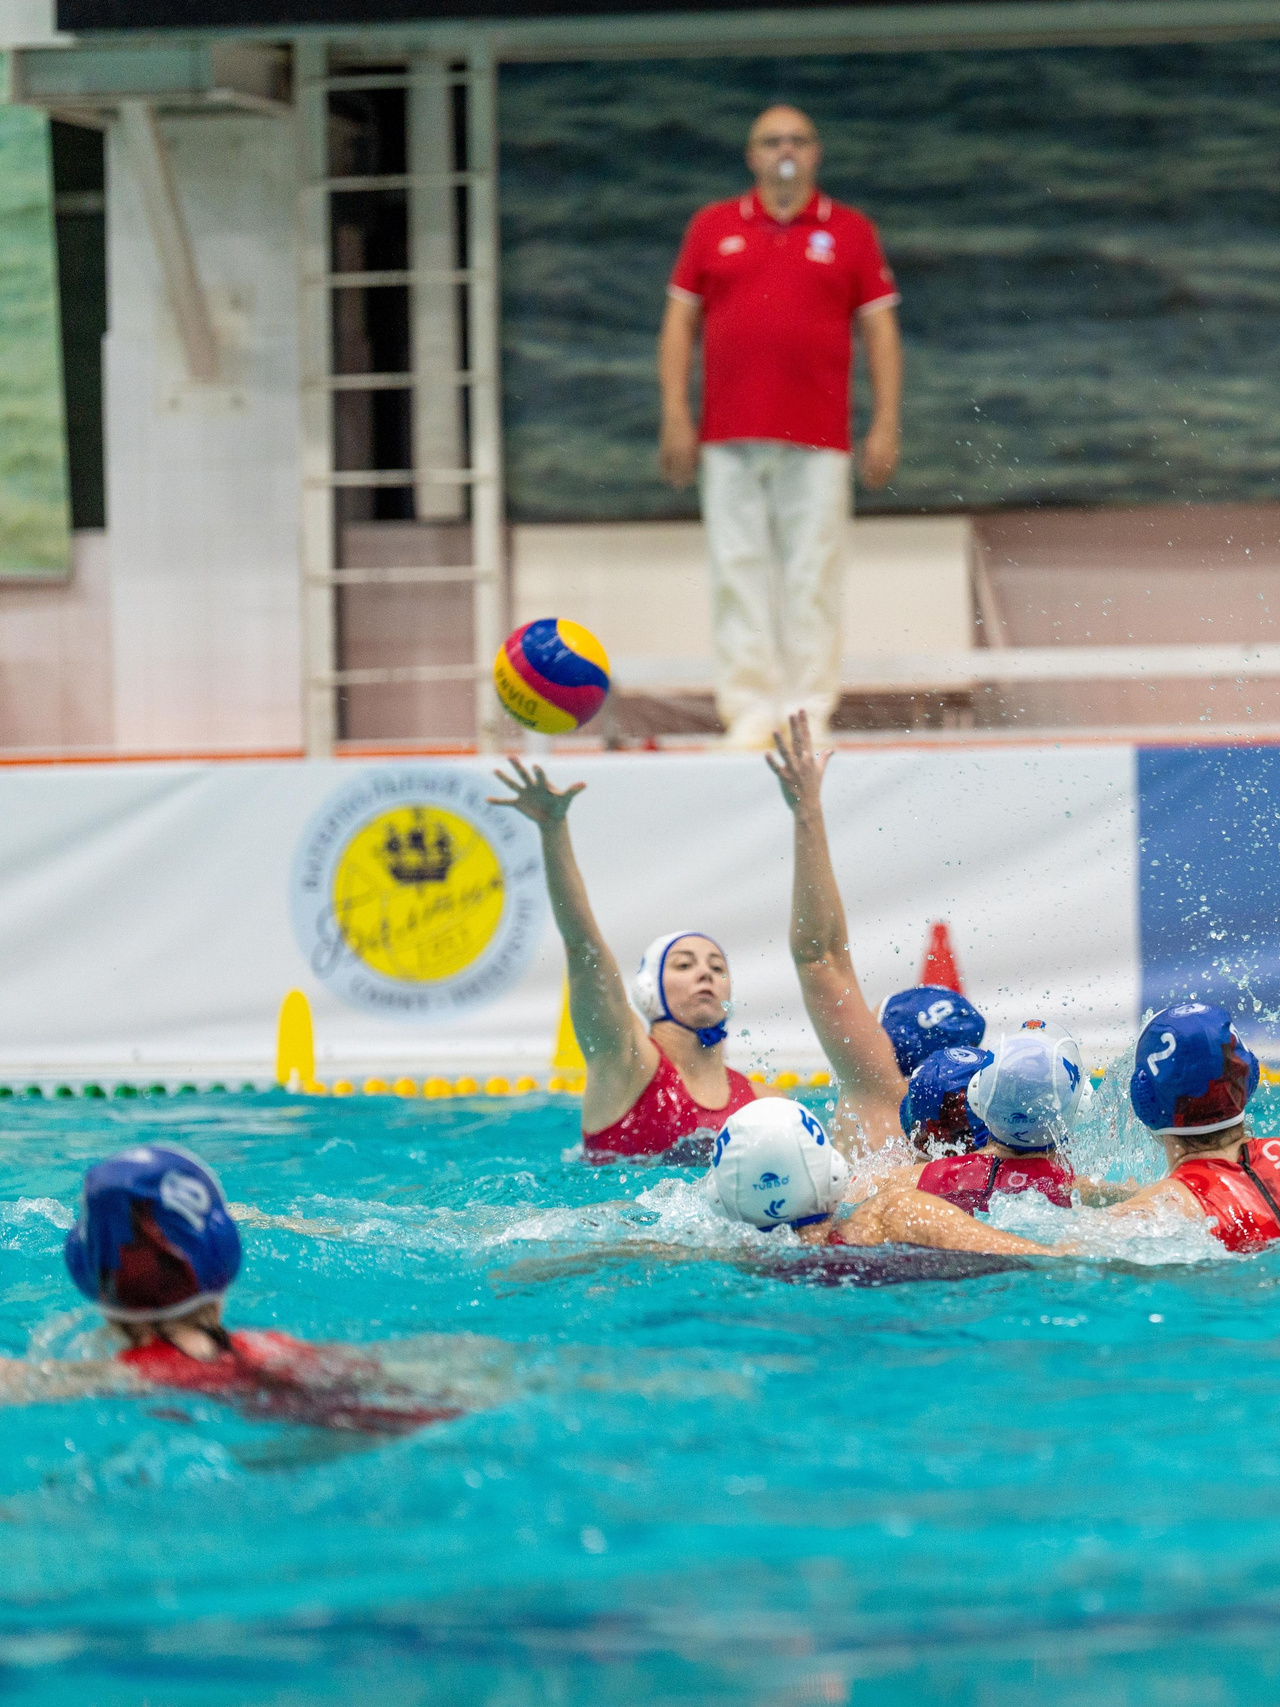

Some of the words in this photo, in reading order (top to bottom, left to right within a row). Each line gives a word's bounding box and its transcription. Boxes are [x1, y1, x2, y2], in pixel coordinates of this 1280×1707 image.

[1147, 1032, 1177, 1077] 2
[798, 1108, 825, 1146] 5
[1003, 1116, 1037, 1124] TURBO
[752, 1177, 789, 1191] TURBO
